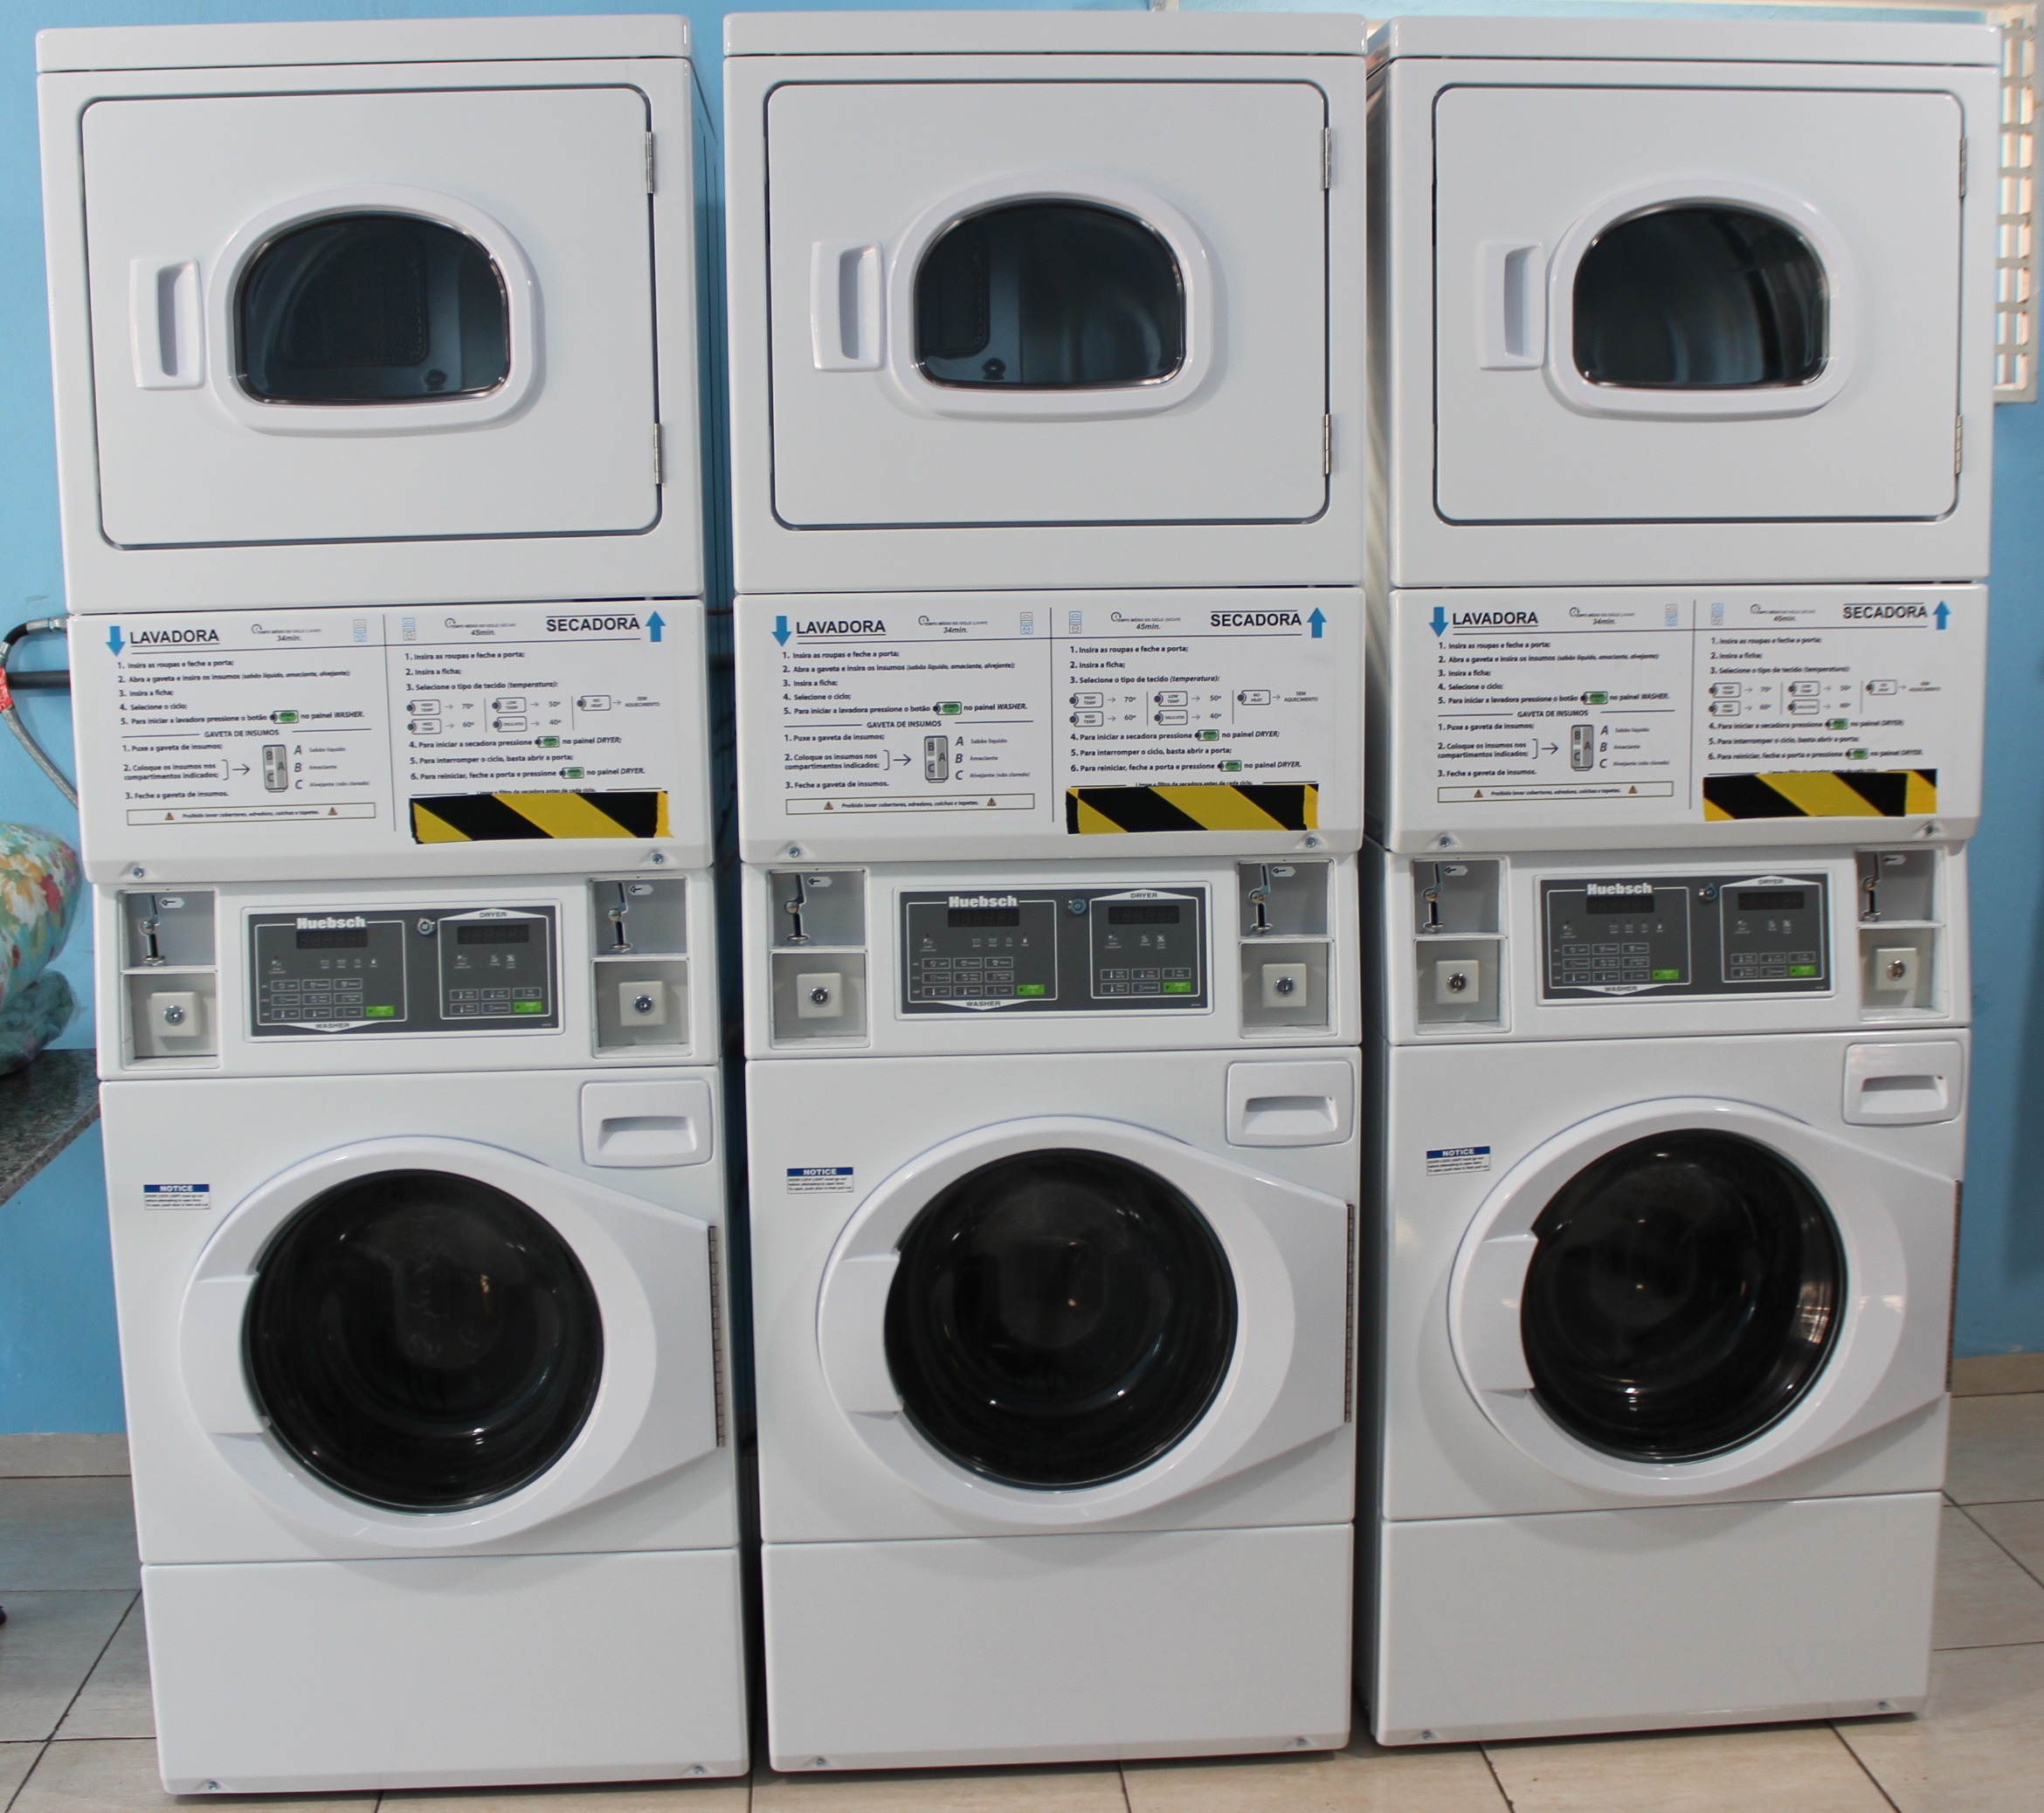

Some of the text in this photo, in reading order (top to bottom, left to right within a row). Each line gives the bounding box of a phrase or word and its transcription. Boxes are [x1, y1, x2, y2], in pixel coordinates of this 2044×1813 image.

[1843, 605, 1927, 619] SECADORA
[1211, 613, 1302, 627] SECADORA
[1453, 611, 1538, 626] LAVADORA
[546, 617, 640, 632] SECADORA
[796, 620, 886, 634] LAVADORA
[130, 630, 219, 645] LAVADORA
[783, 706, 791, 715] 5.
[928, 742, 935, 751] B
[955, 736, 963, 746] A
[938, 753, 946, 762] A
[955, 754, 963, 763] B
[928, 763, 935, 773] C
[1070, 764, 1079, 772] 6.
[955, 770, 963, 780] C
[1587, 883, 1652, 895] Huebsch
[948, 896, 1018, 908] Huebsch
[296, 916, 366, 930] Huebsch
[1442, 1148, 1475, 1156] NOTICE
